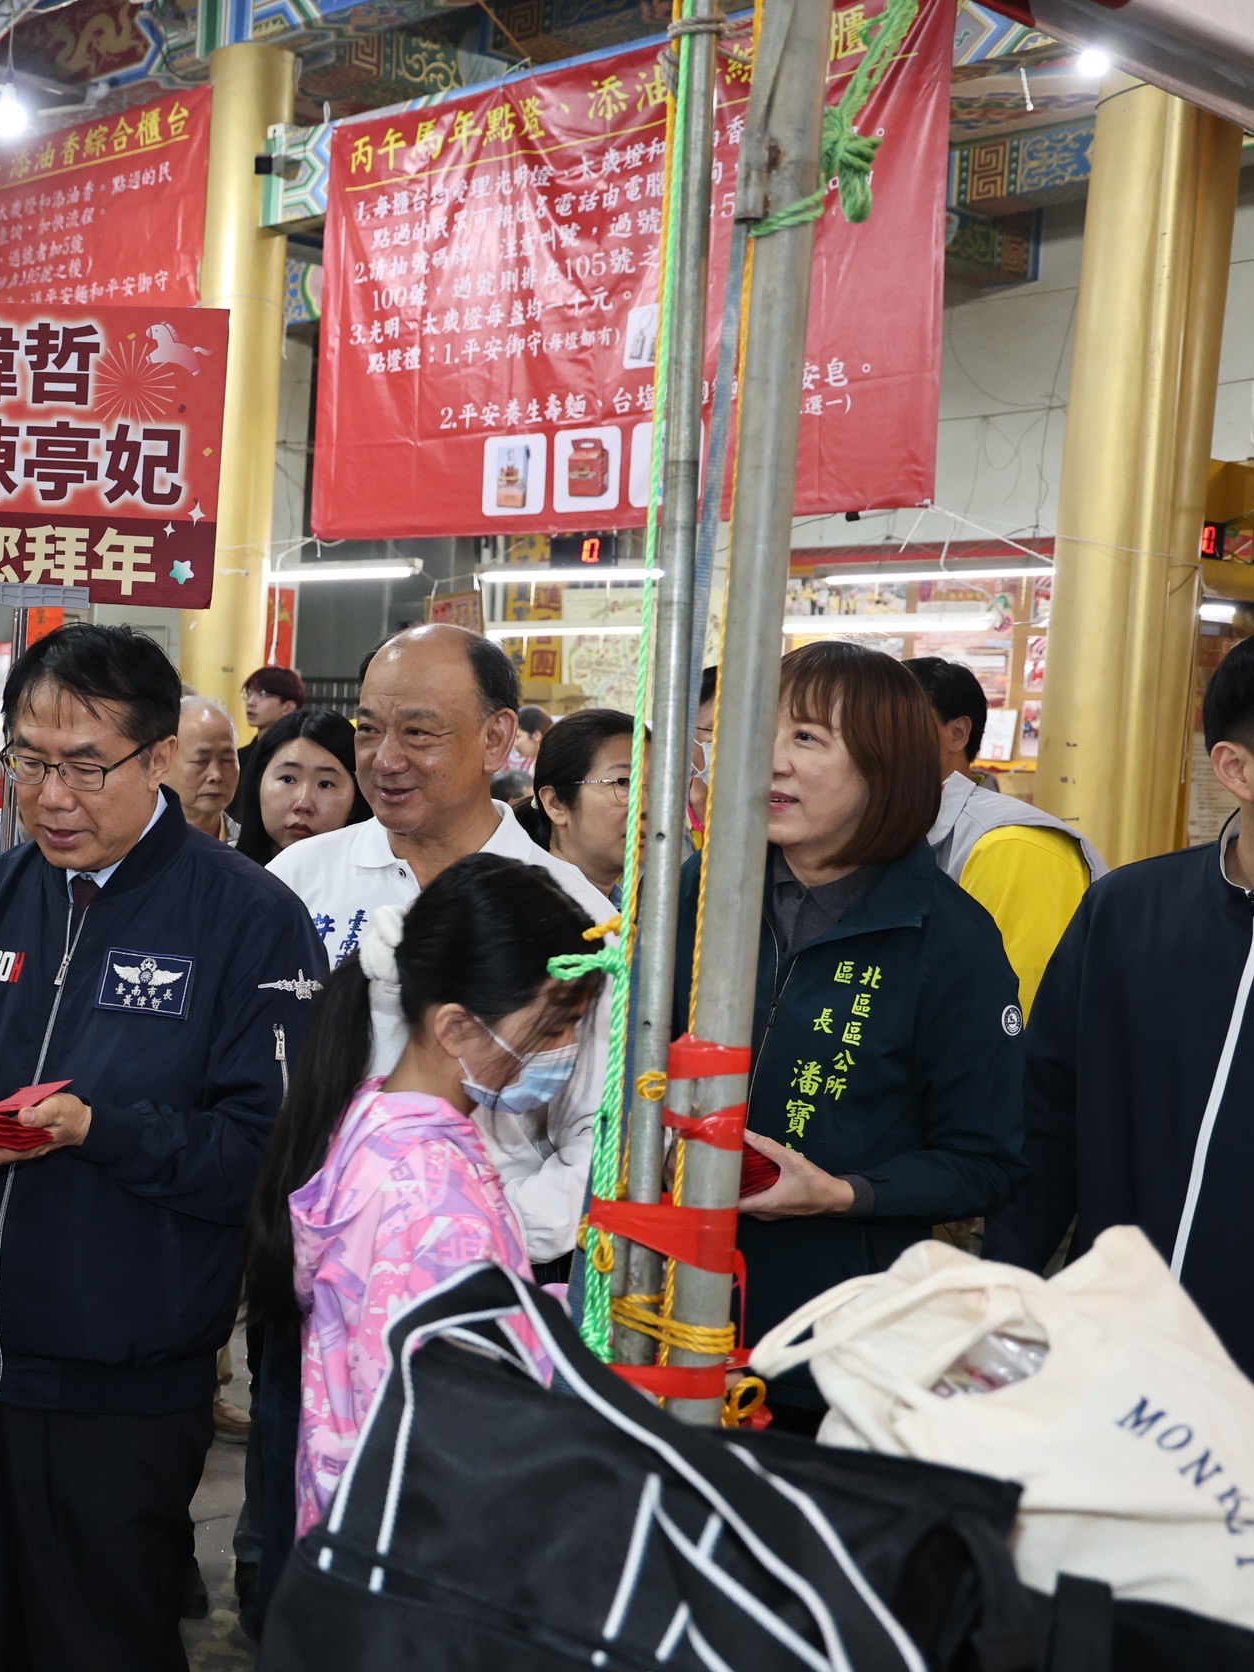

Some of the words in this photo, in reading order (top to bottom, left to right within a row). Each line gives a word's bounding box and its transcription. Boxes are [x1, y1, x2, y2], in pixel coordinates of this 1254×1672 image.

[122, 994, 163, 1010] 黃偉哲
[823, 965, 882, 1101] 北區區公所
